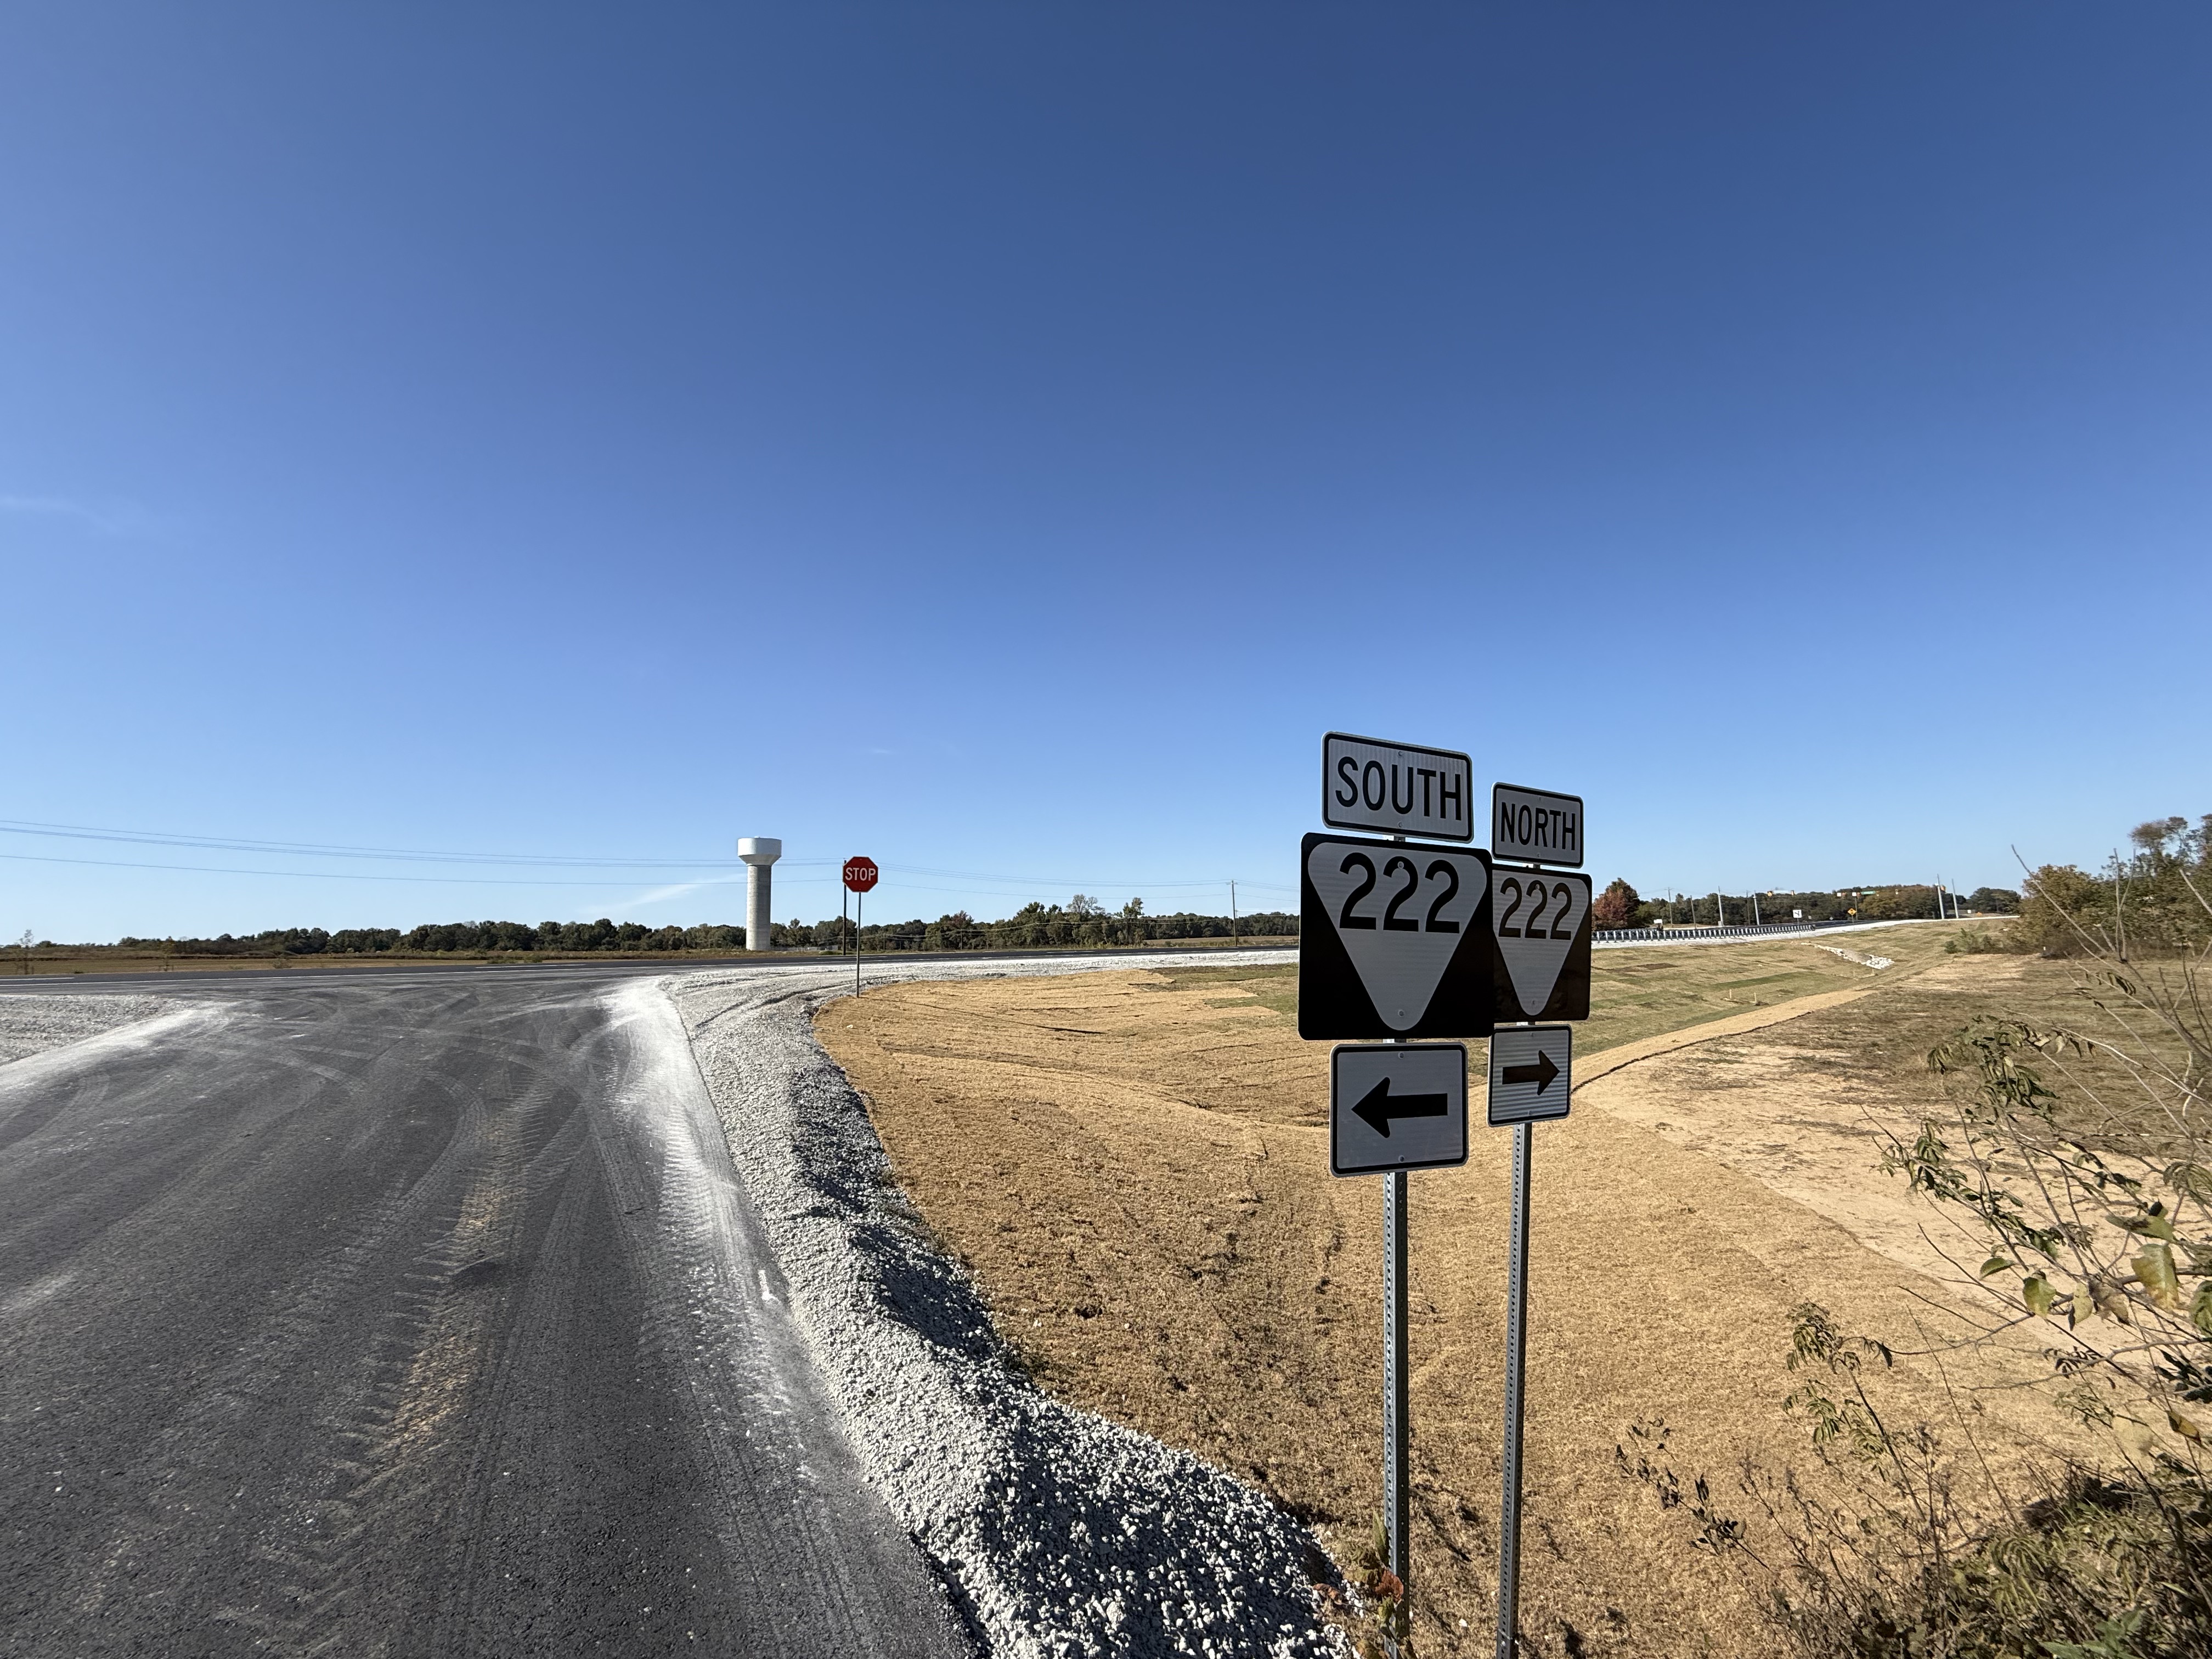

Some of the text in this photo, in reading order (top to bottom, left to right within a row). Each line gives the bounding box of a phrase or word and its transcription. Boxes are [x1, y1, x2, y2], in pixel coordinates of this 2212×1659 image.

[1335, 755, 1462, 821] SOUTH
[1500, 802, 1576, 851] NORTH
[845, 867, 876, 881] STOP
[1339, 852, 1460, 934] 222
[1498, 877, 1572, 940] 222
